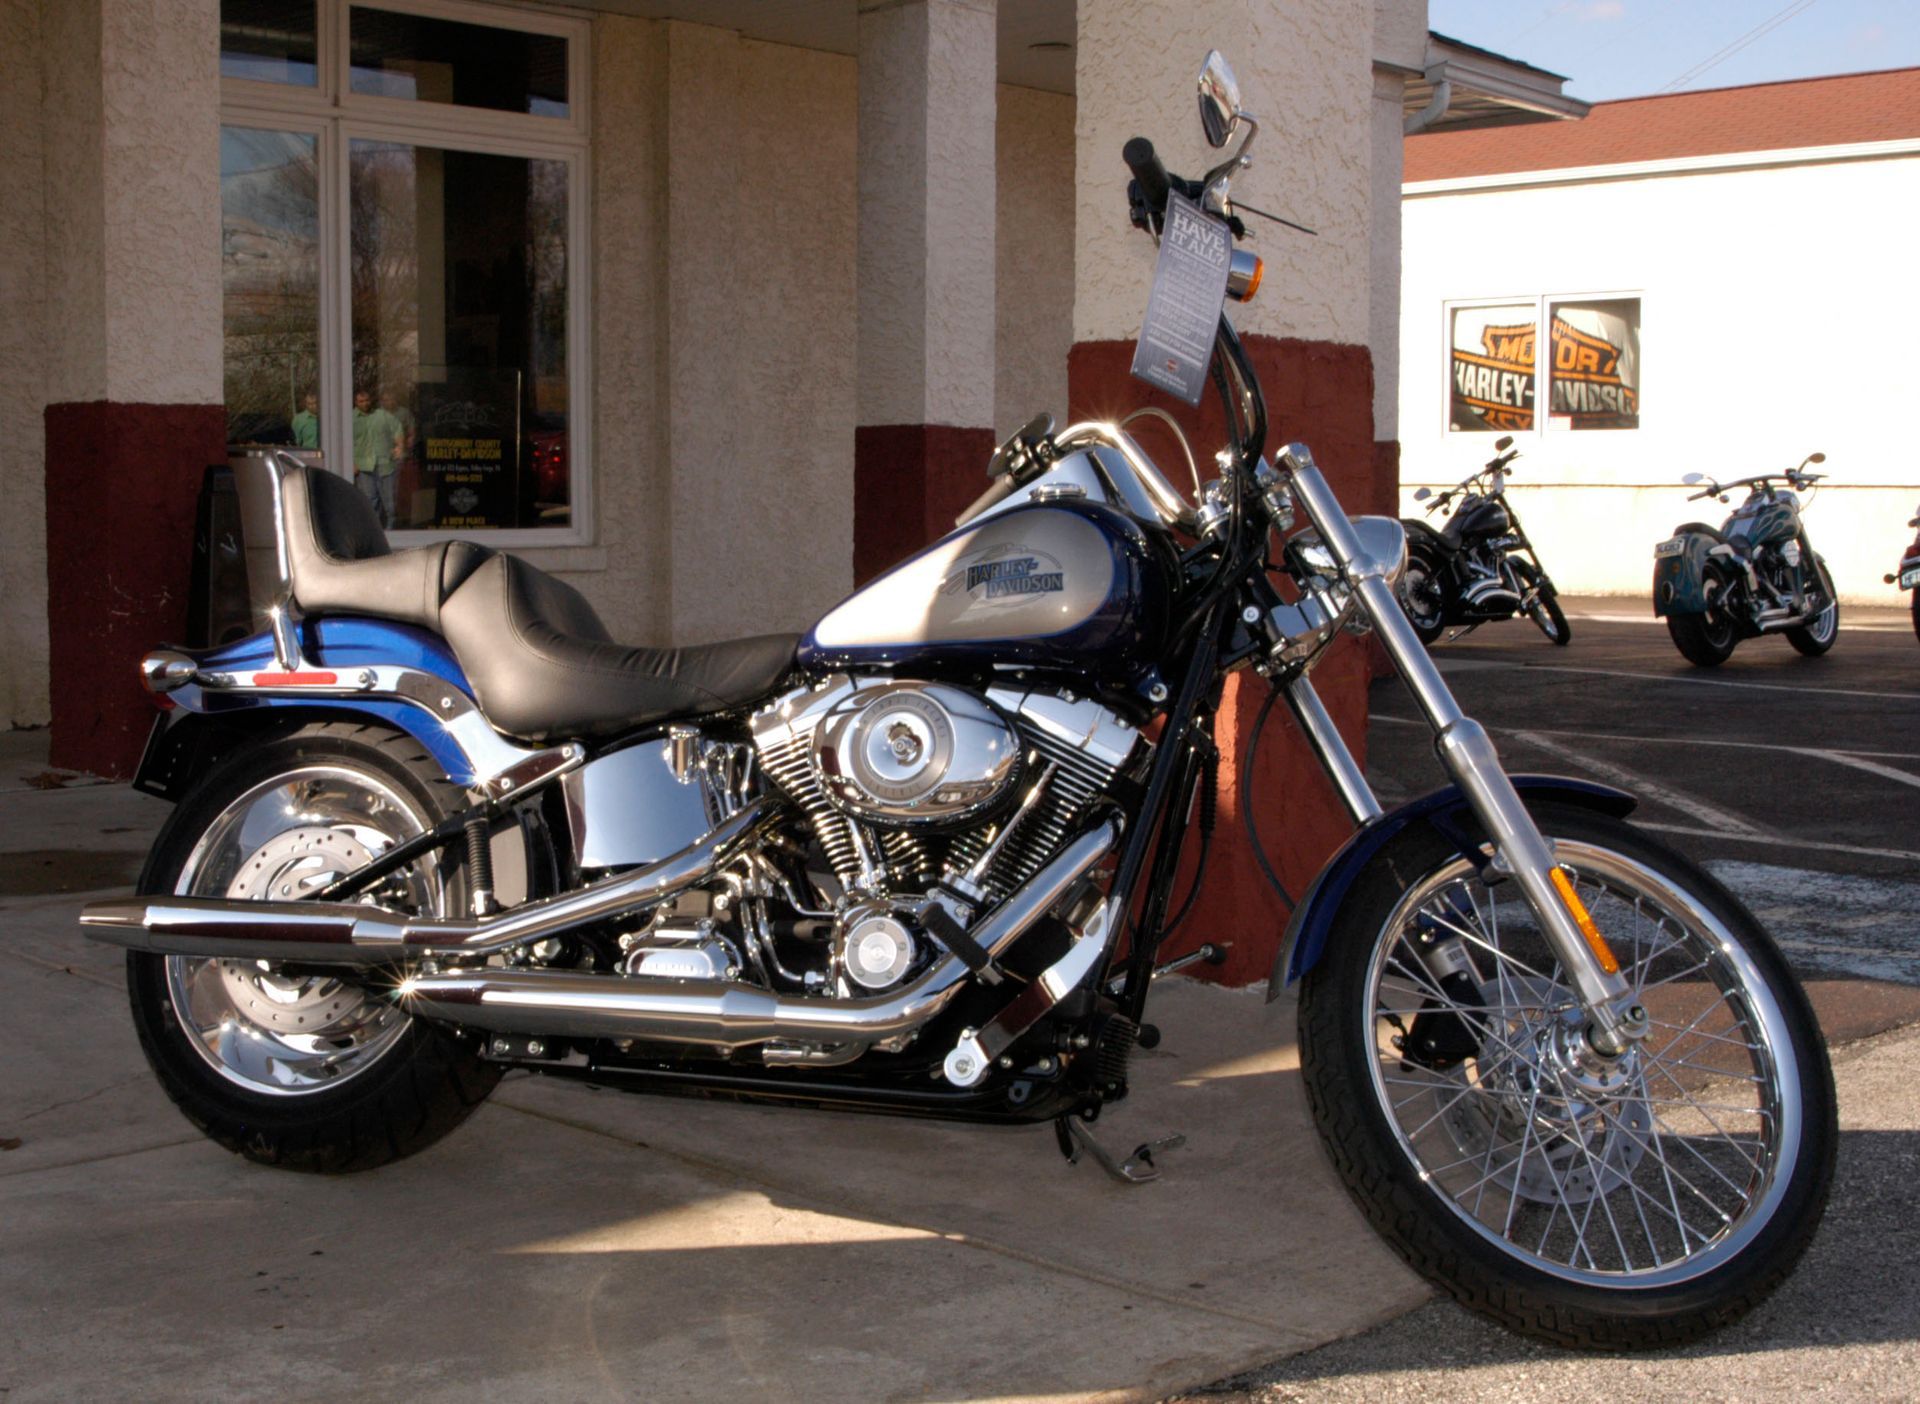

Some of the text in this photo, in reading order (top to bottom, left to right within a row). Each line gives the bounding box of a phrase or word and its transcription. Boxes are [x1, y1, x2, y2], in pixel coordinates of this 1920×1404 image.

[1172, 211, 1225, 253] HAVE
[1169, 228, 1188, 246] IT
[1187, 240, 1225, 267] ALL?
[426, 447, 502, 459] HARLEY-DAVIDSON
[474, 439, 501, 448] COUNTY
[967, 558, 1039, 592] HARLEY-
[986, 573, 1063, 598] DAVIDSON
